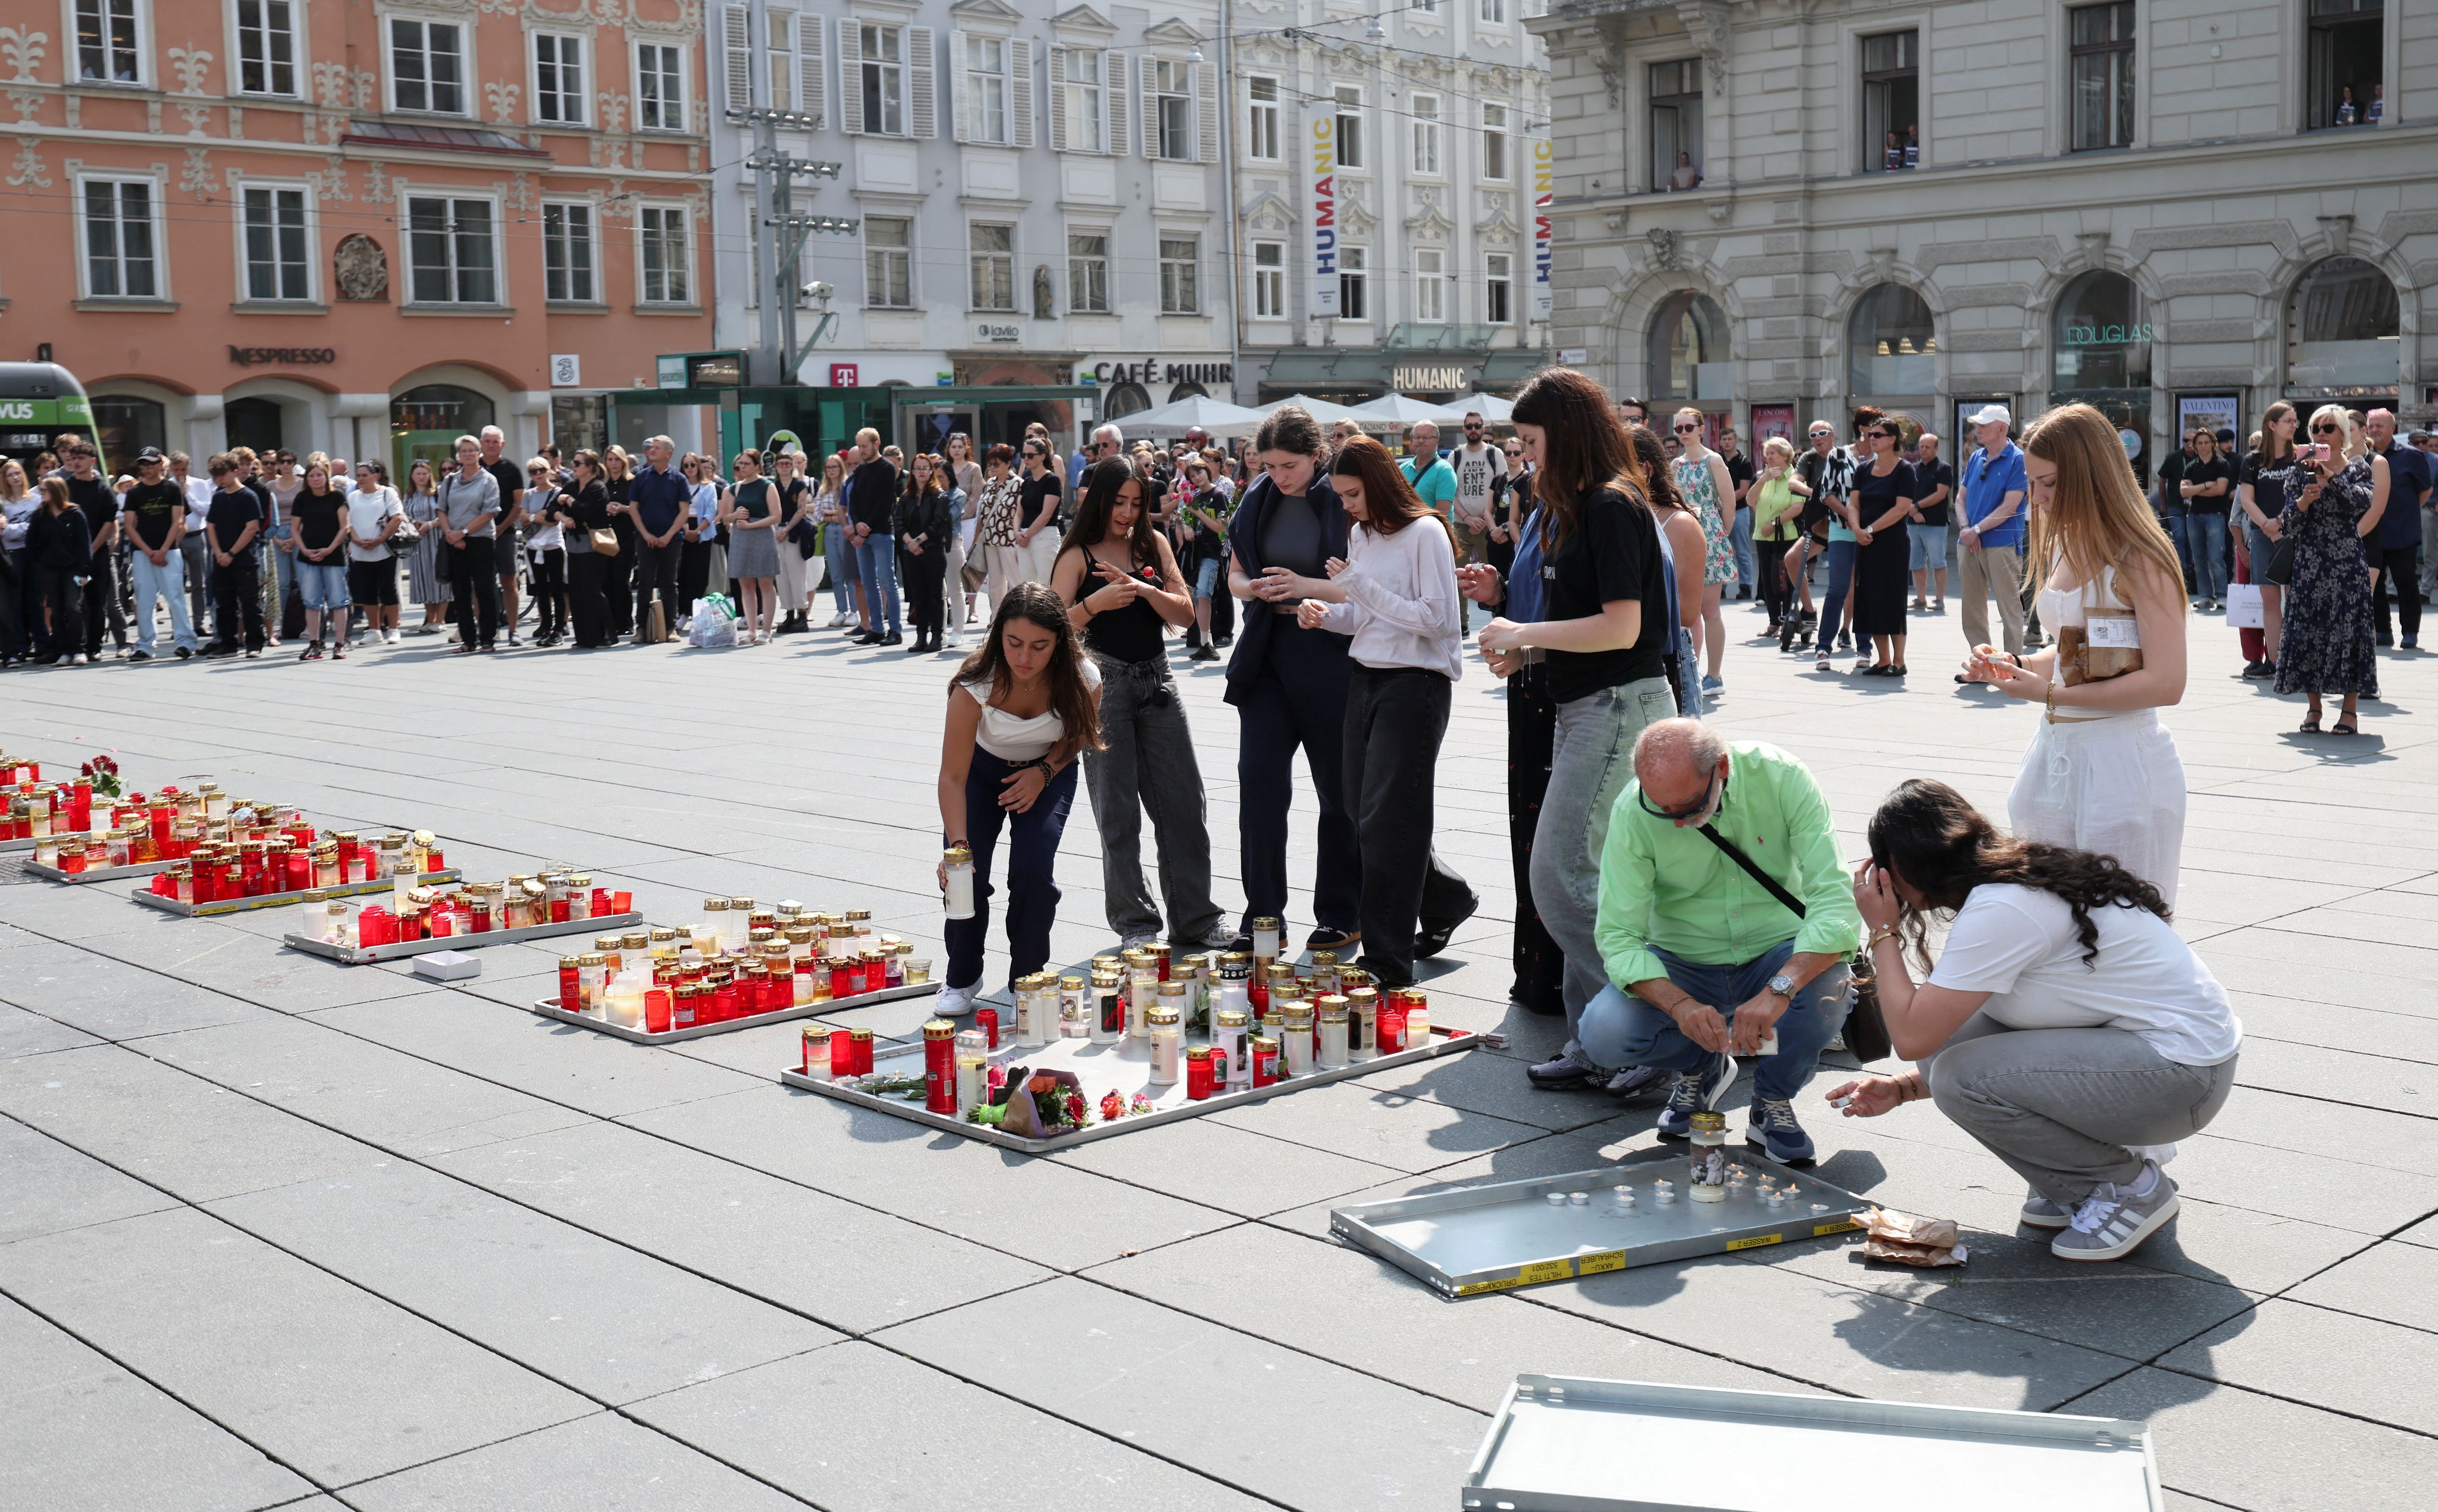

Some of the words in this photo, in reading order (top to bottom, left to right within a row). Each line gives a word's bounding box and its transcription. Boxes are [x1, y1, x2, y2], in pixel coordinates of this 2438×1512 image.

[1313, 117, 1336, 274] HUMANIC
[991, 325, 1019, 336] lavilo
[2068, 324, 2153, 344] DOUGLAS
[225, 344, 335, 367] NESPRESSO
[1094, 358, 1158, 383] CAFÉ
[1167, 363, 1234, 383] MUHR
[1394, 368, 1466, 389] HUMANIC
[2184, 401, 2234, 410] VALENTINO
[2258, 465, 2290, 480] Superd
[1464, 473, 1486, 484] ENT
[1464, 485, 1485, 496] URE
[1829, 1223, 1858, 1232] WASSER
[1743, 1236, 1772, 1246] WASSER
[1581, 1250, 1625, 1264] SCHRAUBER
[1532, 1262, 1558, 1272] 532/001
[1591, 1262, 1614, 1271] AKKU-
[1545, 1271, 1562, 1281] HILTI
[1460, 1279, 1517, 1294] DRUCKMESSER
